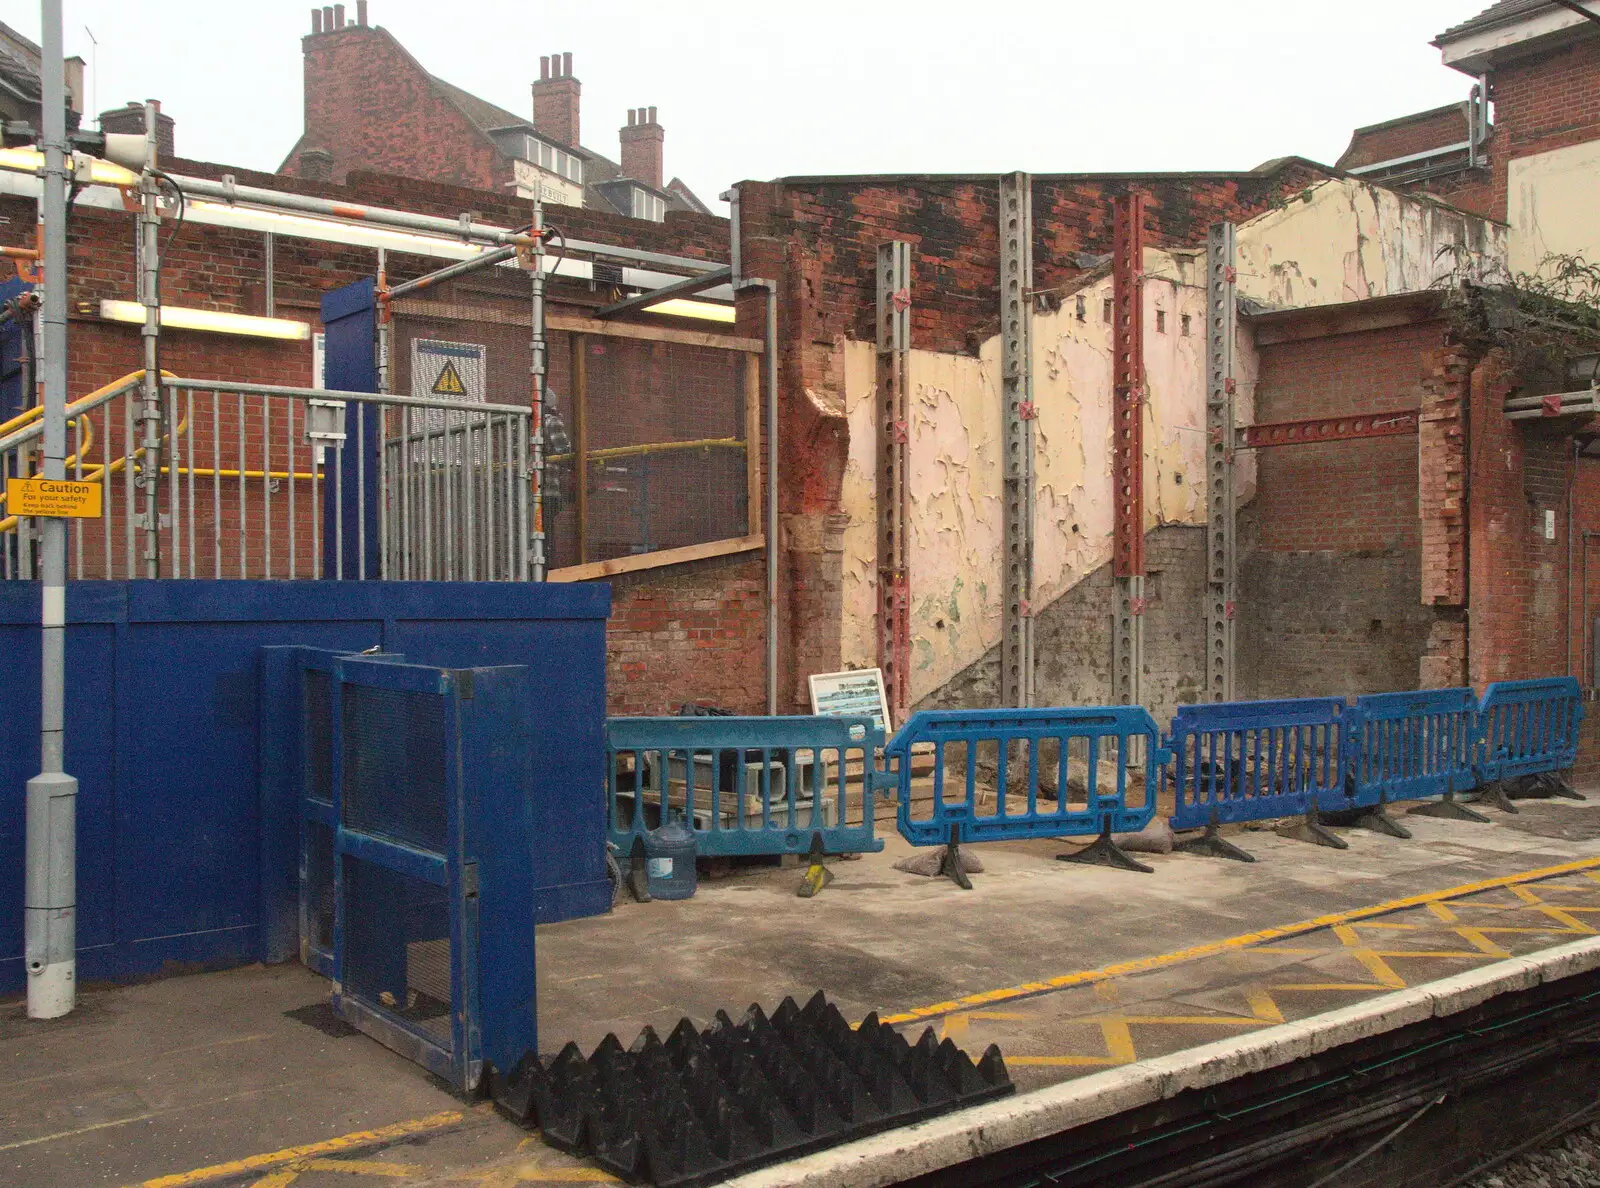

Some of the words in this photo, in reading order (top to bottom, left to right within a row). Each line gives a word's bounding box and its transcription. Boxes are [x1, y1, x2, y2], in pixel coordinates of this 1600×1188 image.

[40, 482, 89, 494] Caution
[40, 494, 58, 502] your
[60, 495, 87, 504] safety
